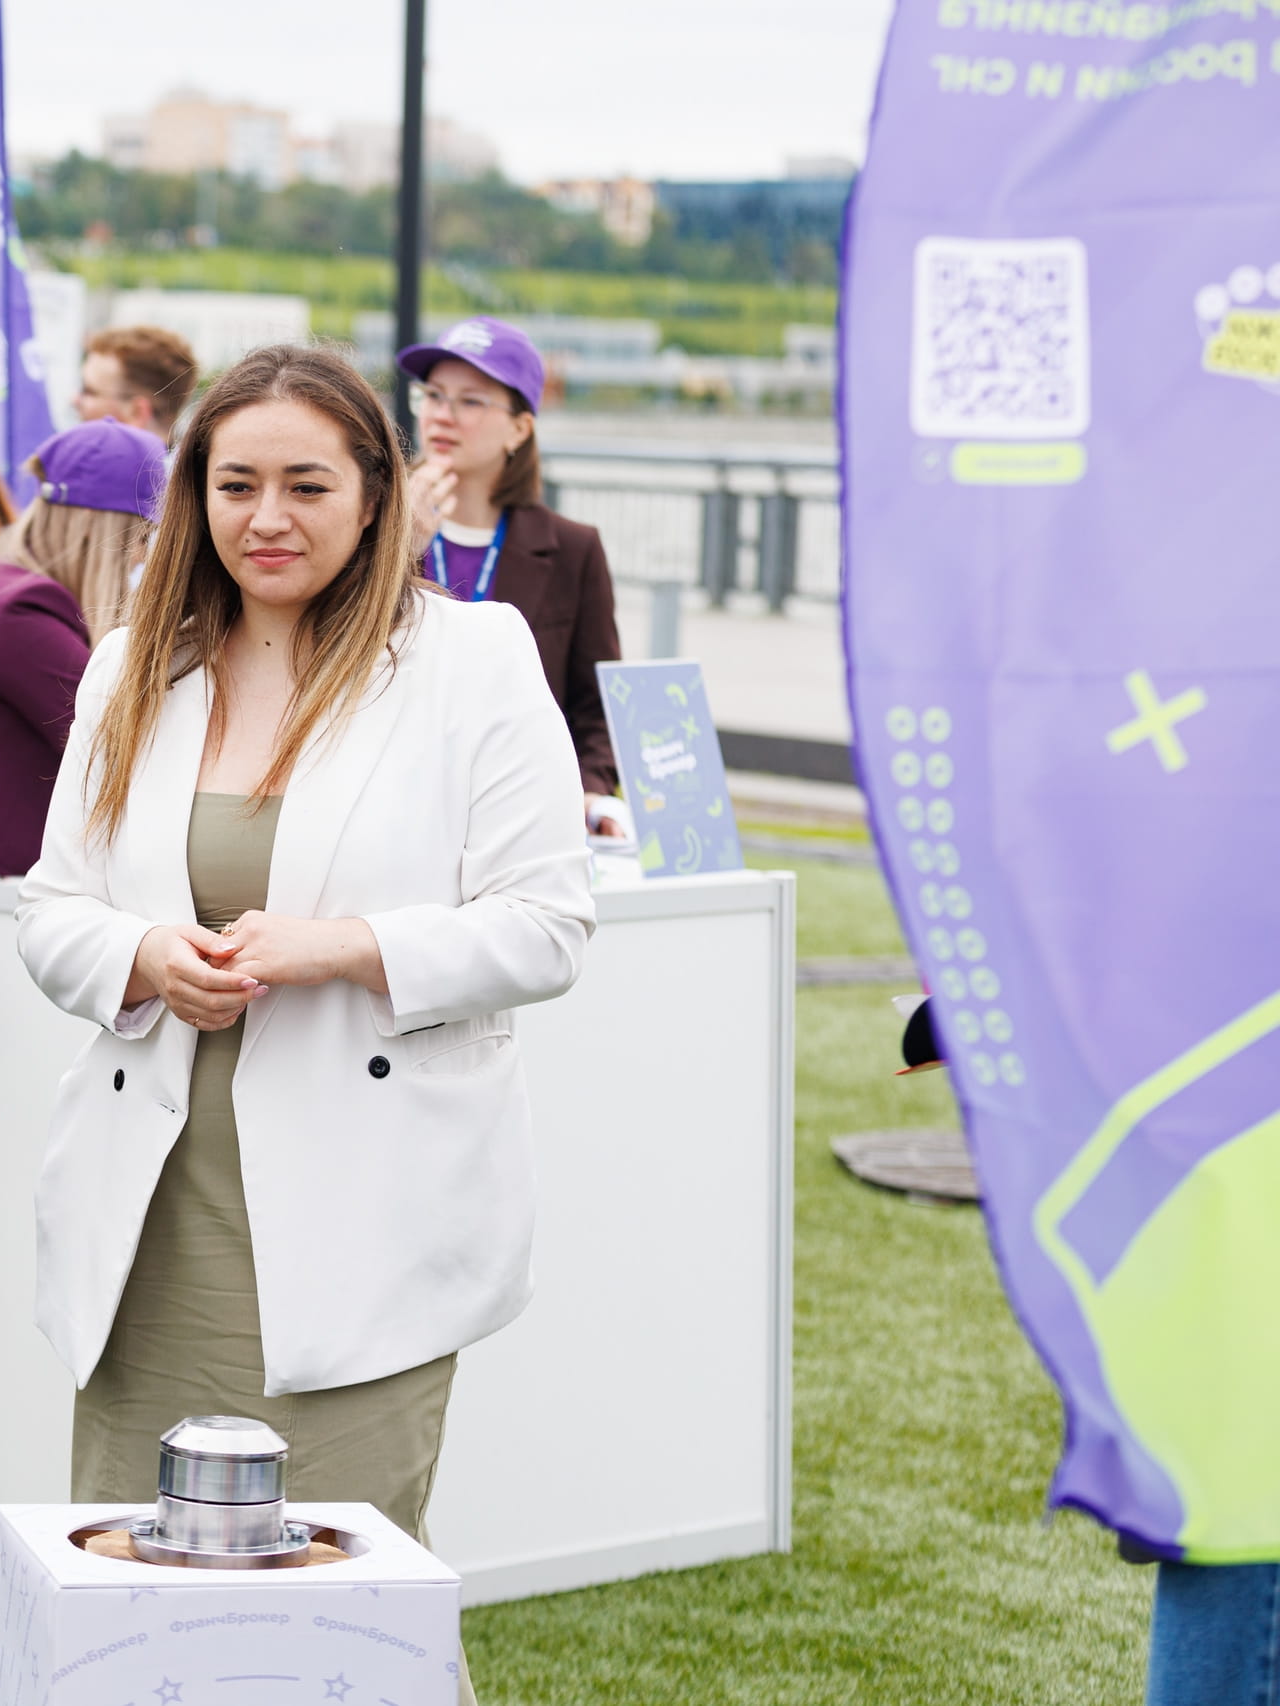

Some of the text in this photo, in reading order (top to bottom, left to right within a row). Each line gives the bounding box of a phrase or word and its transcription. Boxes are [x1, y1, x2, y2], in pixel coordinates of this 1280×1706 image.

[51, 1612, 427, 1685] ранчБрокер ФранчБрокер ФранчБрокер
